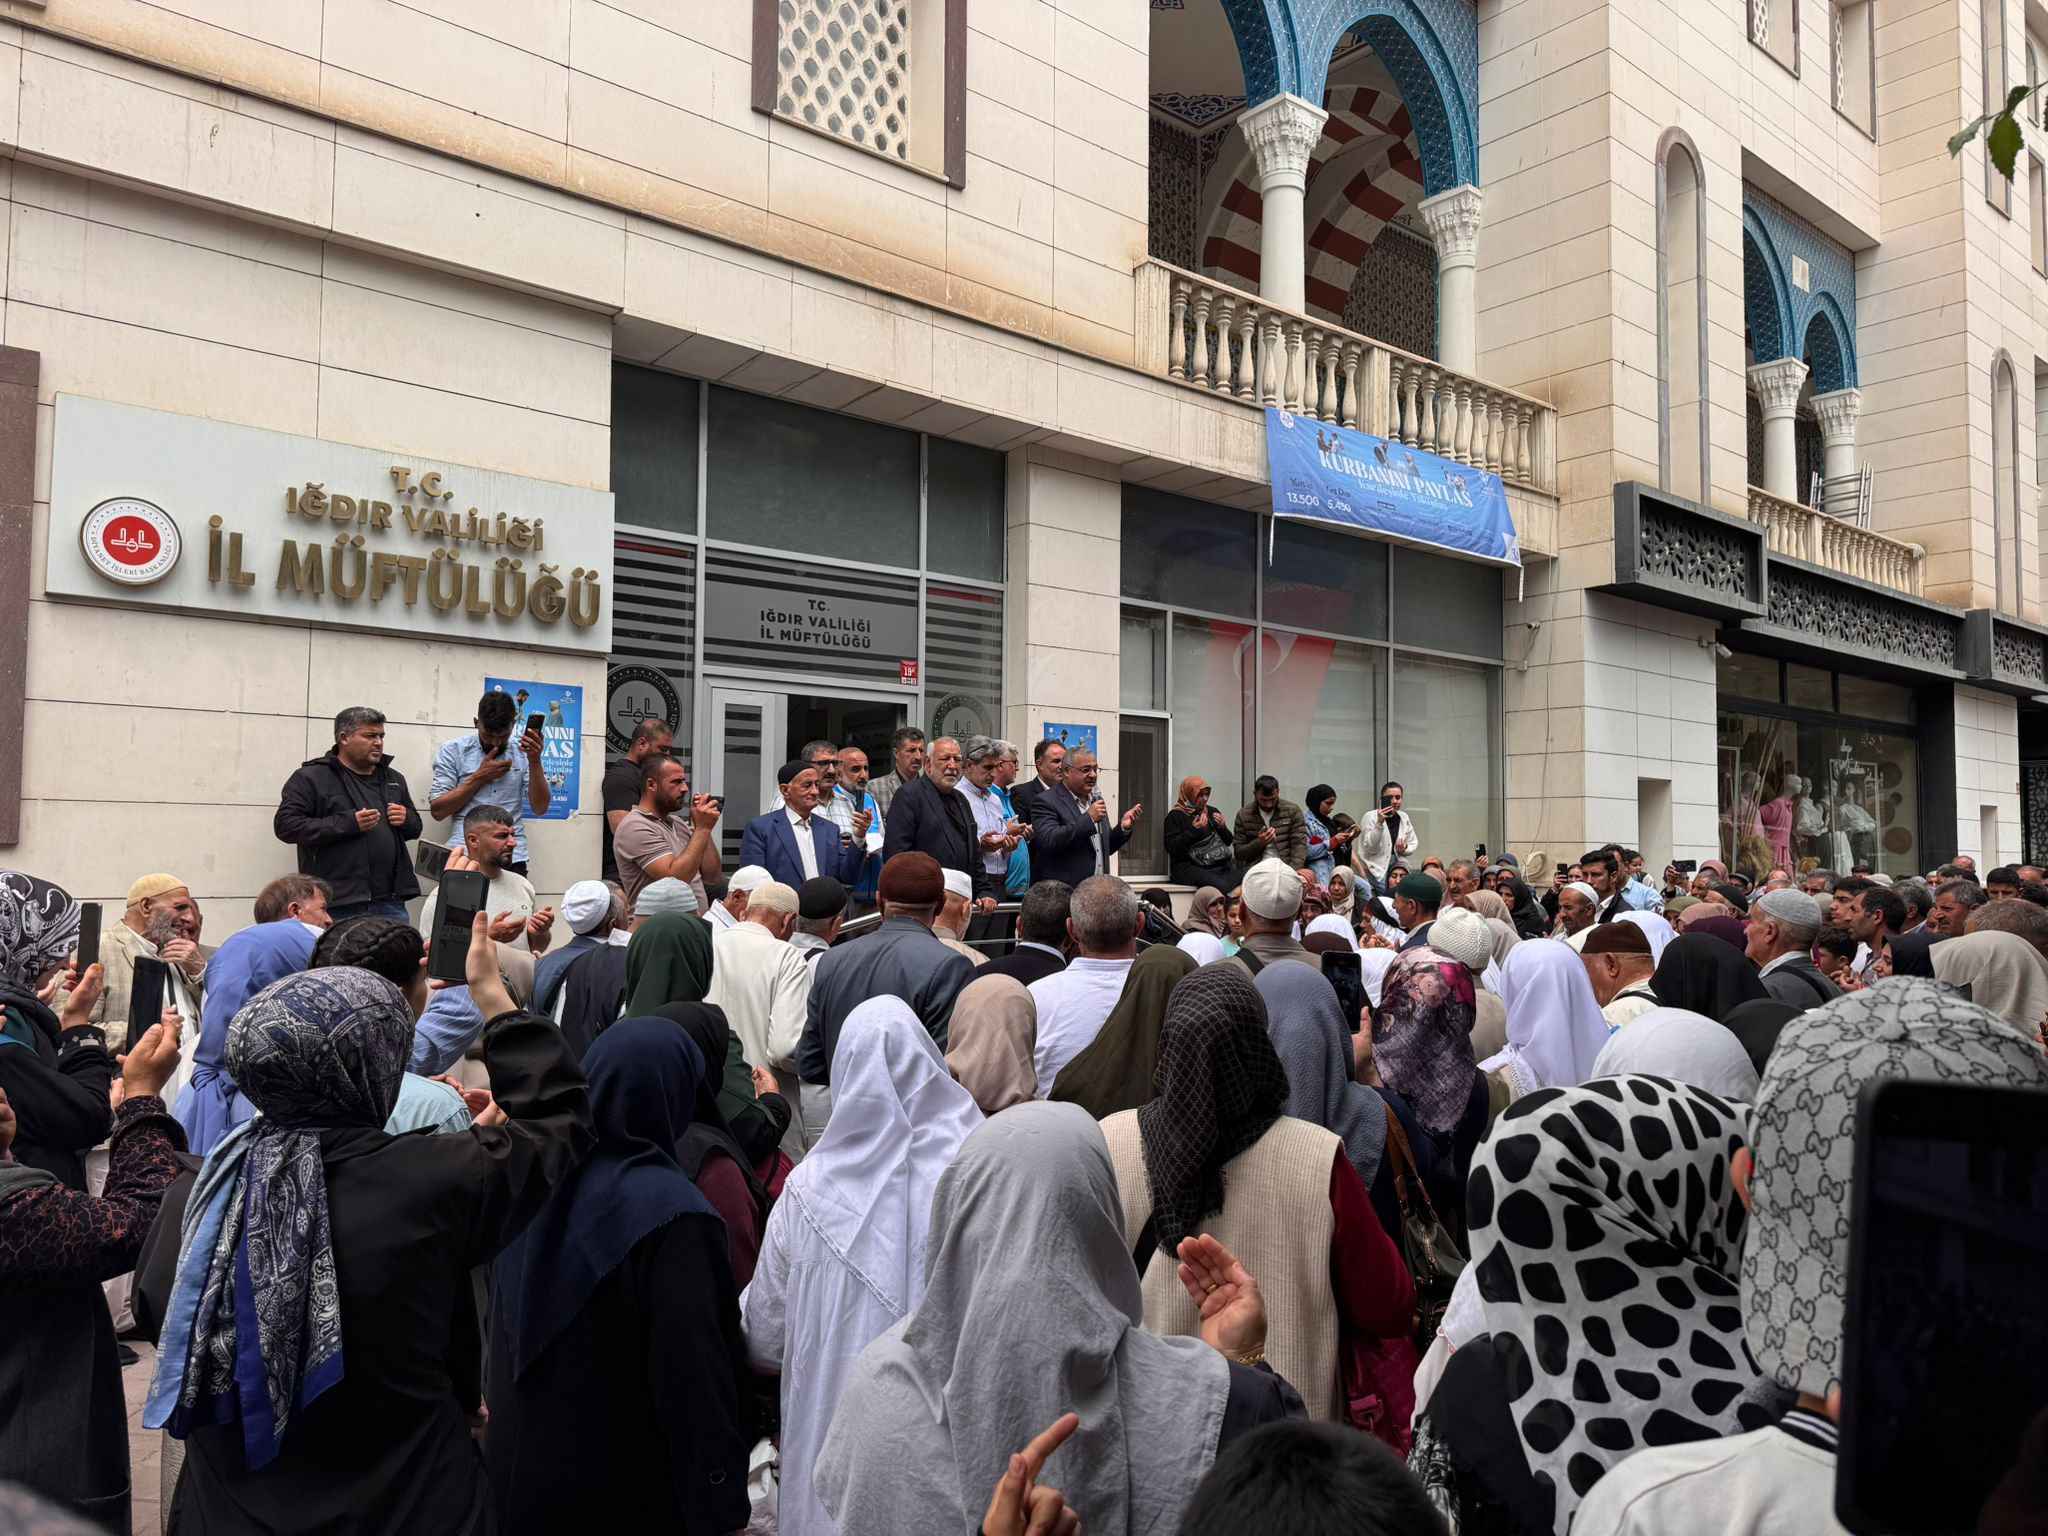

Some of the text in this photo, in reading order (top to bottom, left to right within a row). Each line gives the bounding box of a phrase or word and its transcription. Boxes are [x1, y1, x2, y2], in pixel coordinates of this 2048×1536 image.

[389, 465, 455, 501] T.C.
[1286, 492, 1320, 507] 13.500
[286, 481, 544, 552] IĞDIR VALİLİĞİ
[90, 536, 173, 576] DİYANET İŞLERİ BAŞKANLIĞI
[207, 514, 602, 629] İL MÜFTÜLÜĞÜ
[760, 608, 871, 634] IĞDIR VALİLİĞİ
[807, 599, 830, 612] T.C.
[760, 624, 871, 649] İL MÜFTÜLÜĞÜ
